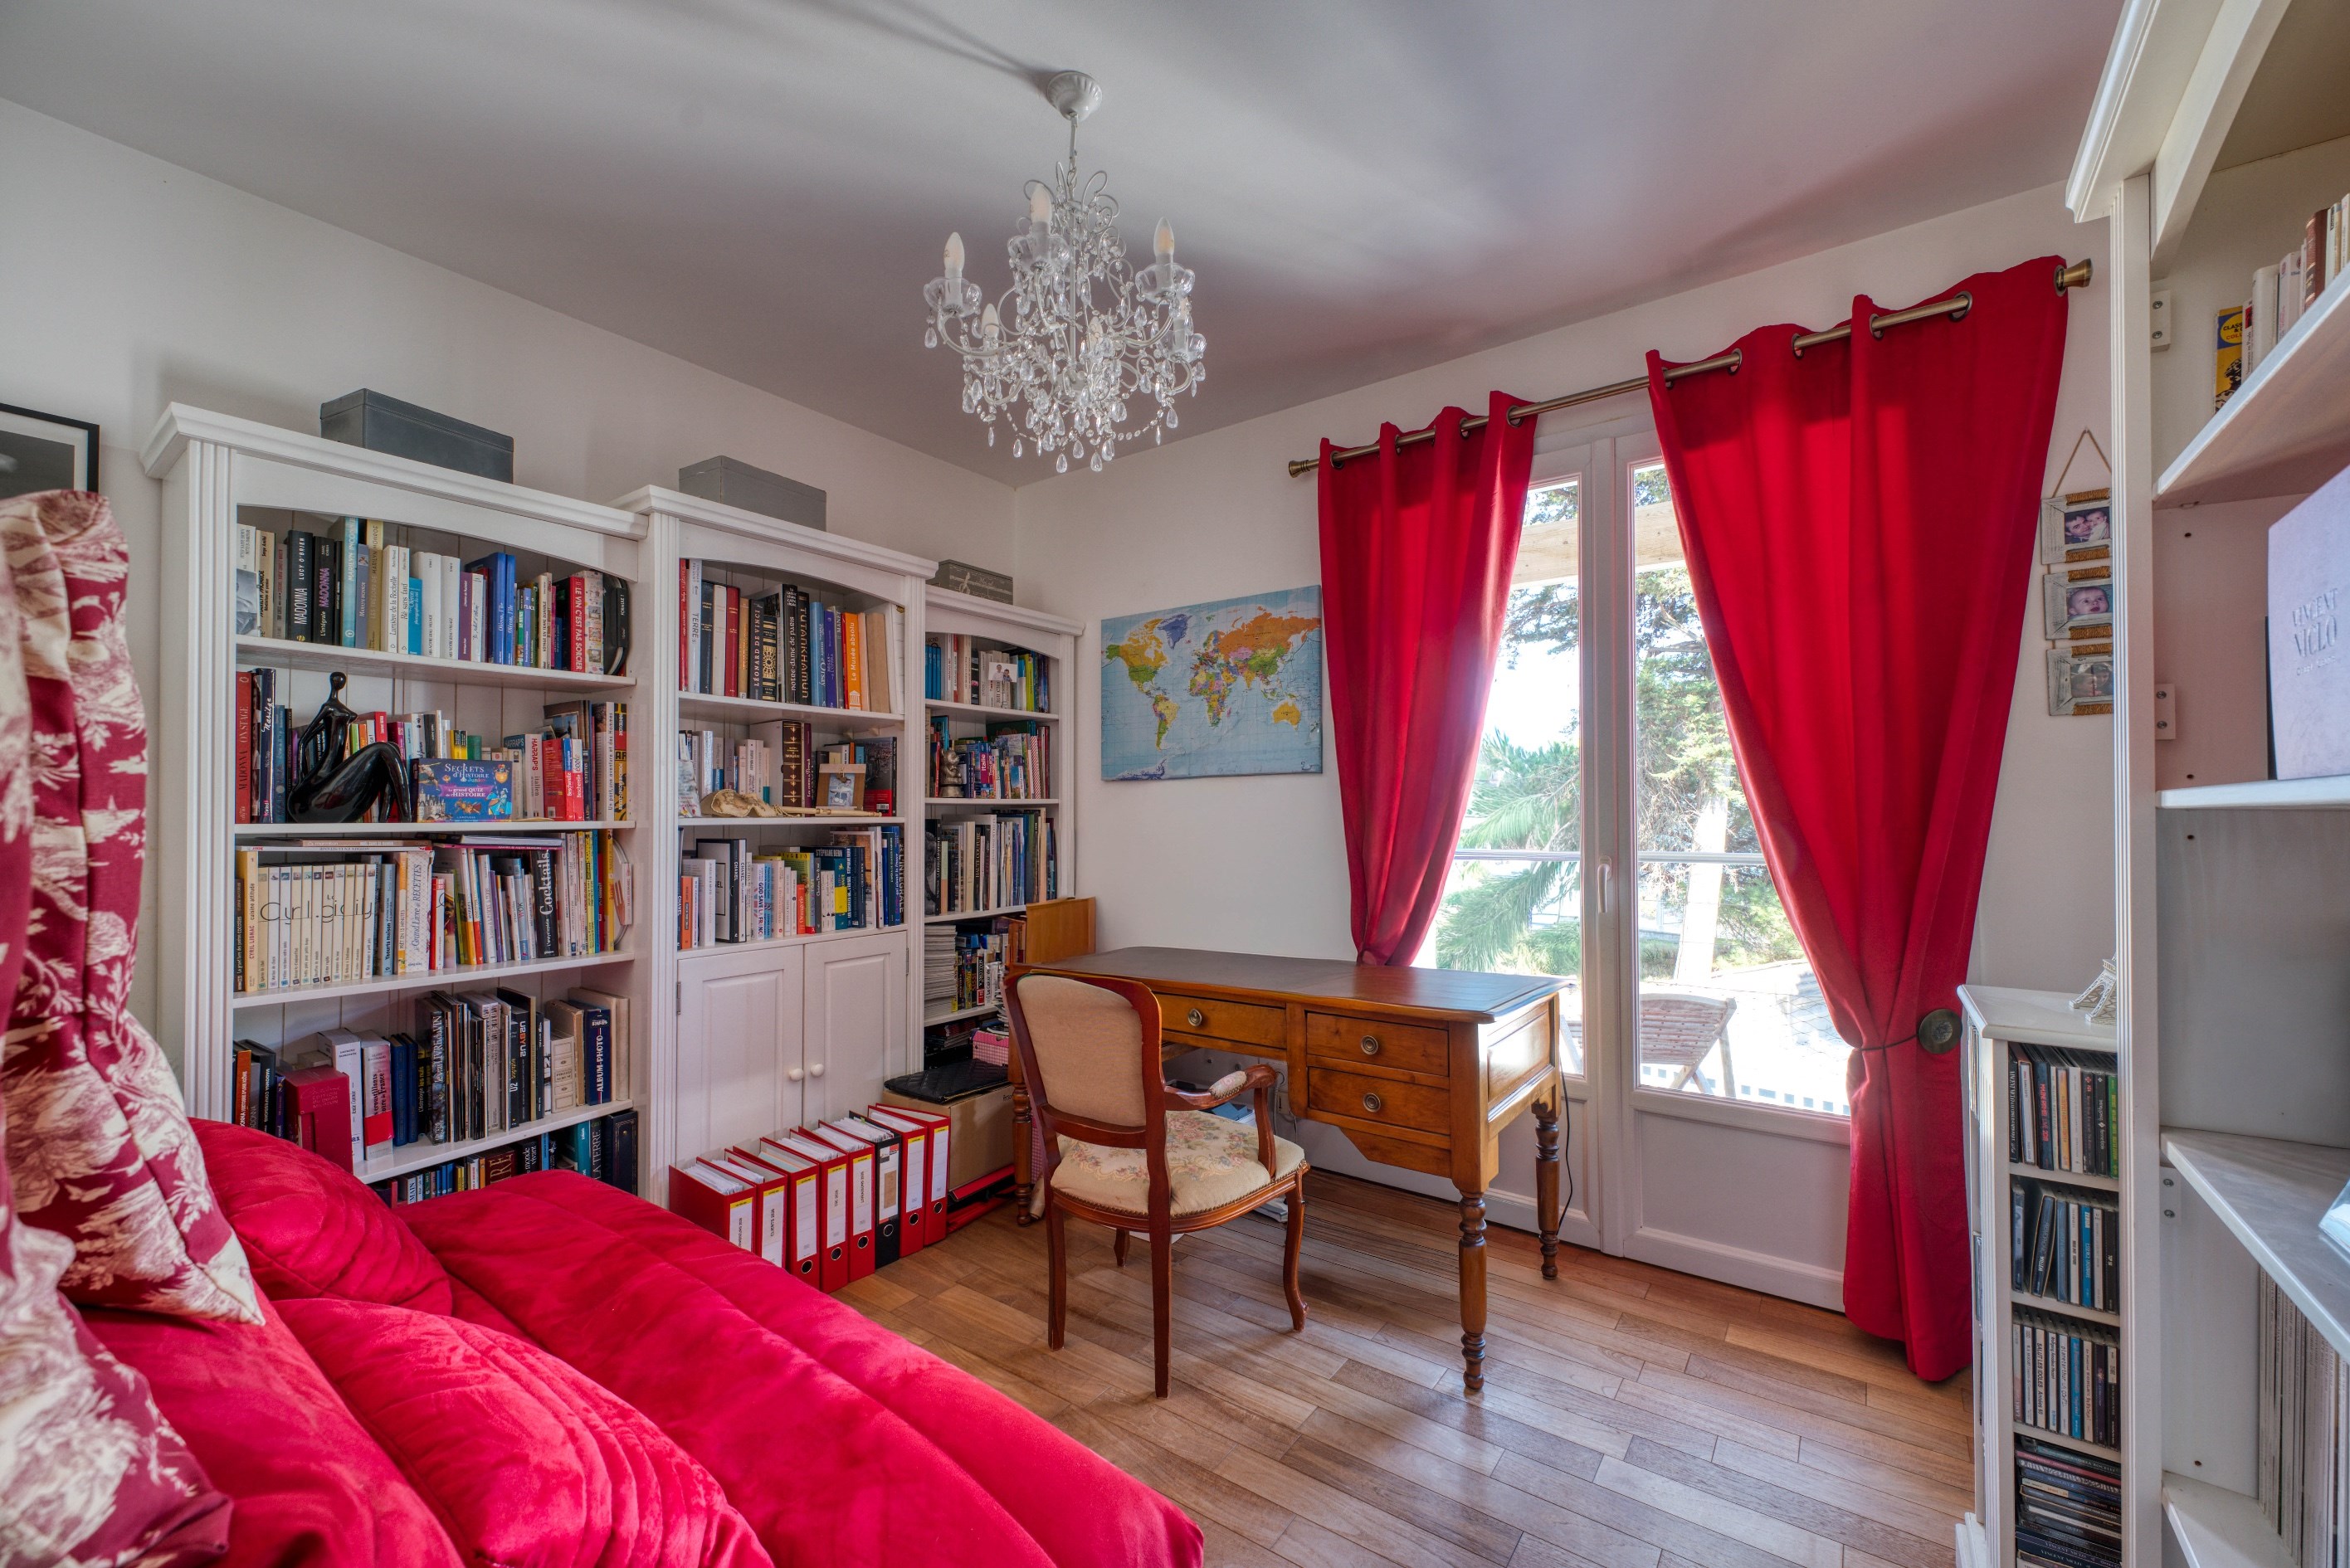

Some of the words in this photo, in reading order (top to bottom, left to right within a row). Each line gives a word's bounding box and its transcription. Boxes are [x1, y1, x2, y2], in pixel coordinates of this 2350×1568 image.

[2223, 323, 2242, 331] CLASS
[319, 567, 330, 607] MADONNA
[294, 587, 308, 625] MADONNA
[755, 635, 760, 646] DE
[239, 706, 248, 731] STAGE
[238, 750, 247, 790] MADONNA
[445, 763, 485, 772] SECRETS
[412, 864, 422, 902] RECETTES
[537, 853, 553, 915] Cocktails
[412, 908, 421, 927] Livre
[412, 927, 421, 947] Grand
[432, 1016, 442, 1031] VIN
[432, 1039, 443, 1064] LIVRE
[378, 1073, 388, 1094] France
[509, 1082, 519, 1092] U2
[592, 1132, 602, 1166] TERRE
